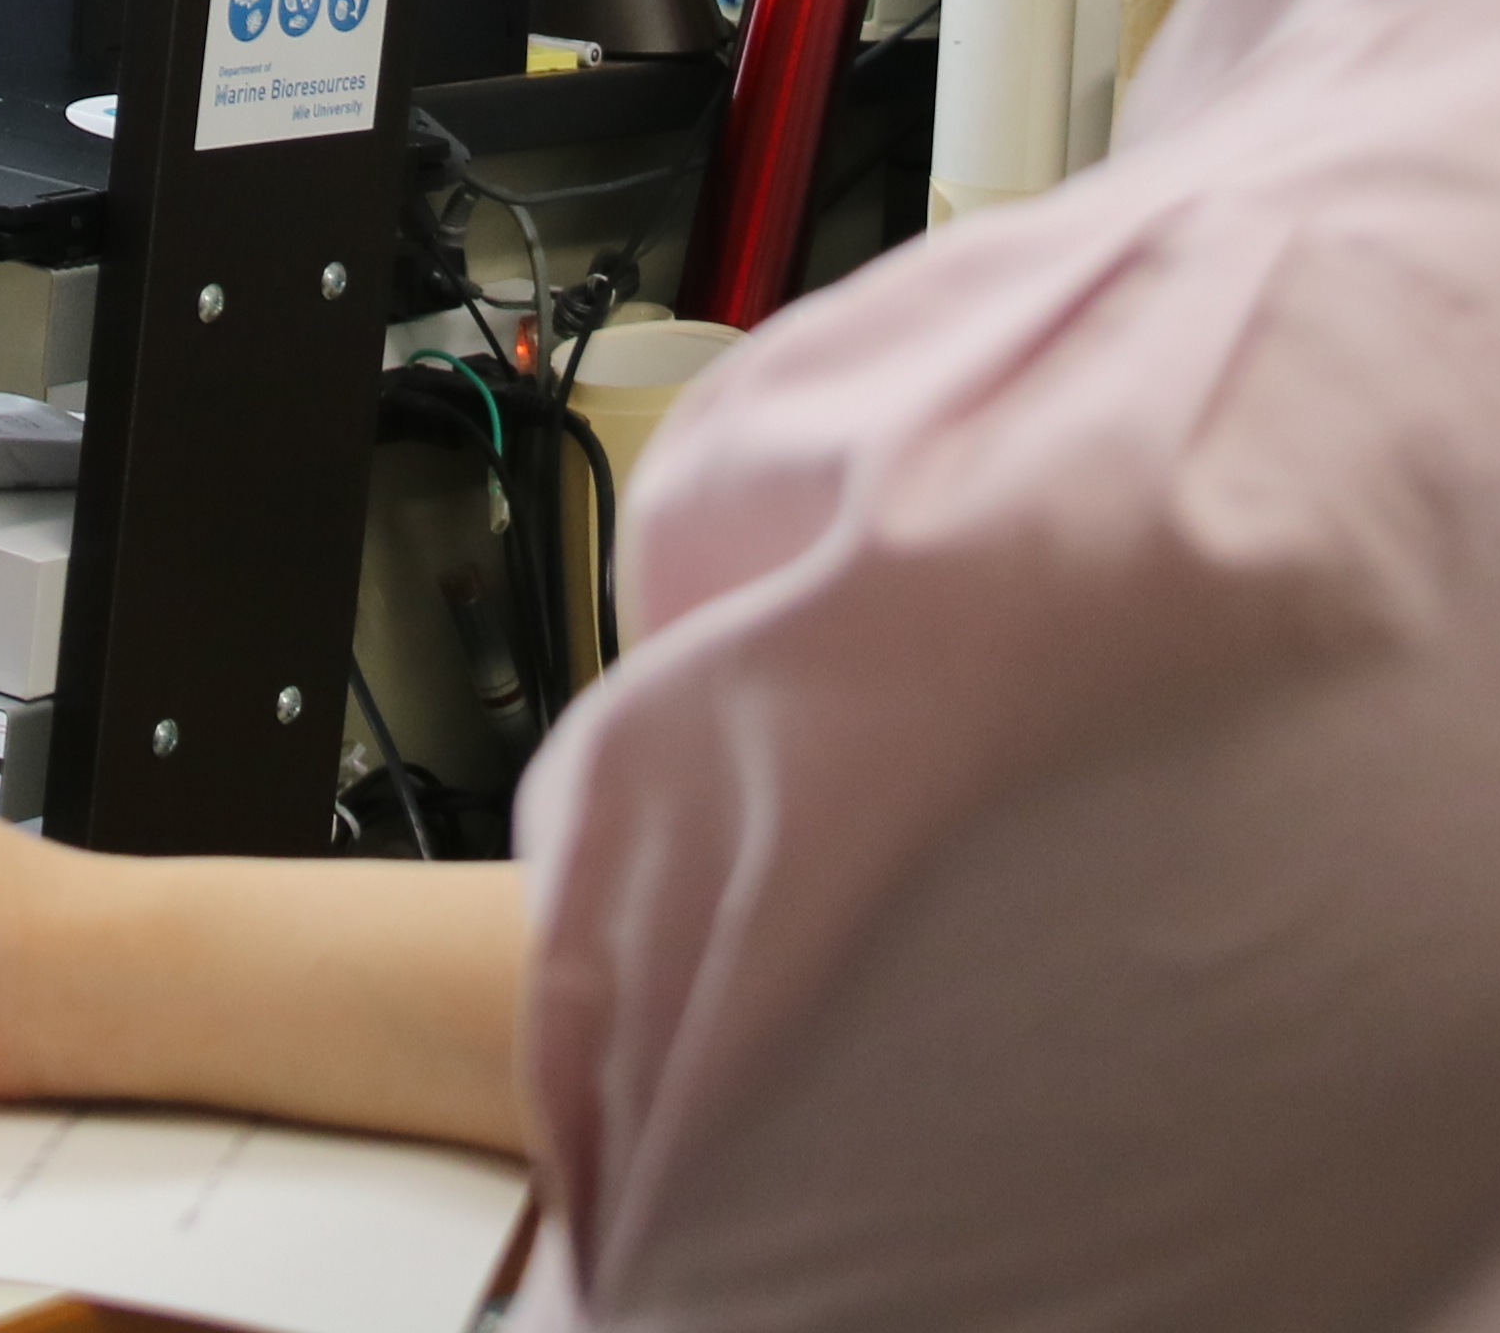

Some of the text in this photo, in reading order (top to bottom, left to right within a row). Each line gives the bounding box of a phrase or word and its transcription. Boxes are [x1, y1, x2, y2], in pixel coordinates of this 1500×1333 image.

[218, 62, 272, 78] Department of
[213, 73, 367, 108] Marine Bioresources
[292, 98, 363, 121] Mie University
